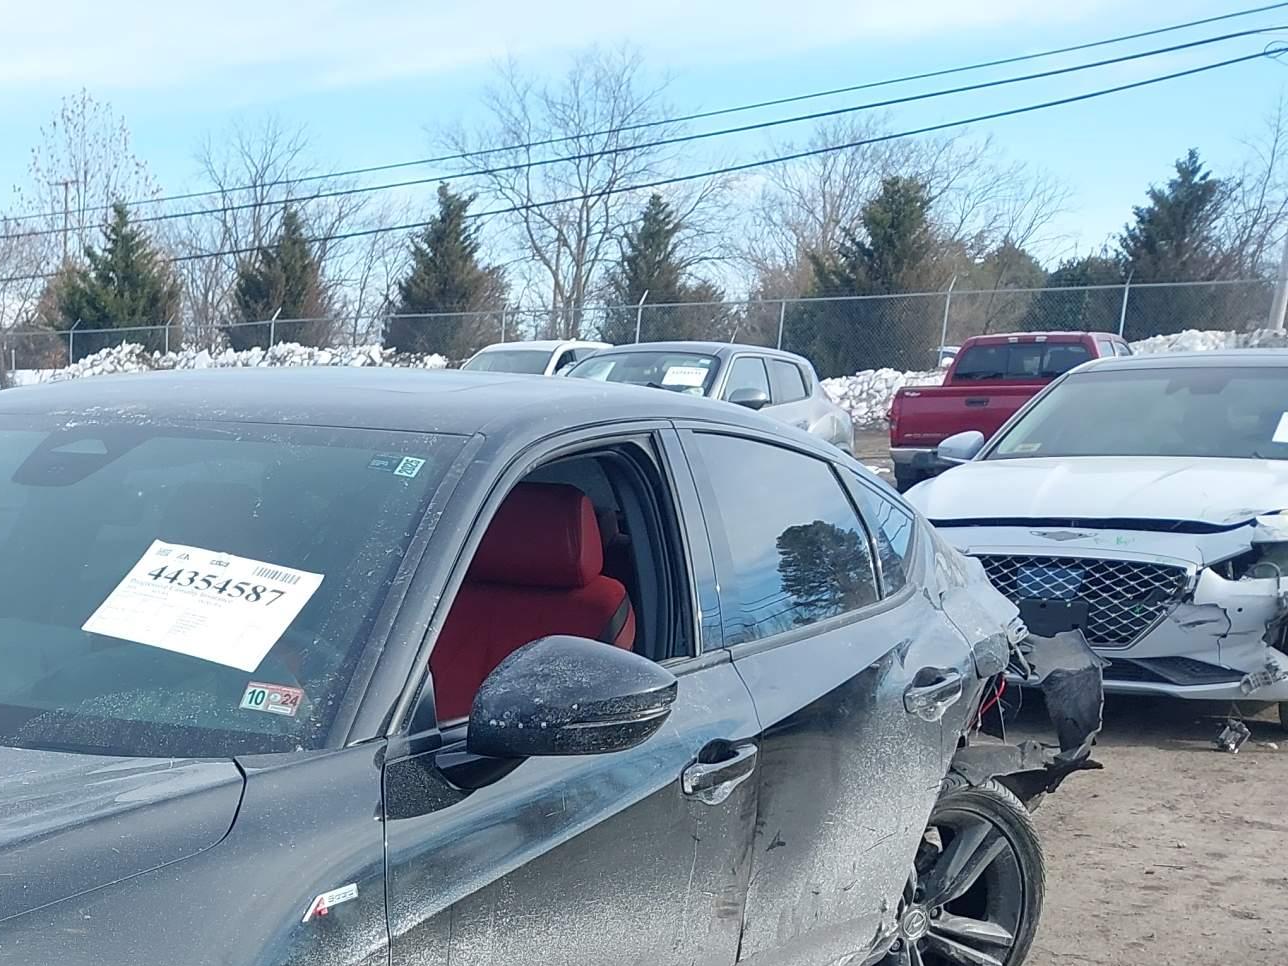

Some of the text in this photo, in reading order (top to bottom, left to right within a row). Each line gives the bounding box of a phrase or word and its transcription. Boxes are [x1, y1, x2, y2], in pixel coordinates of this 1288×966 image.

[148, 565, 287, 606] 44354587
[248, 689, 299, 707] 10 24
